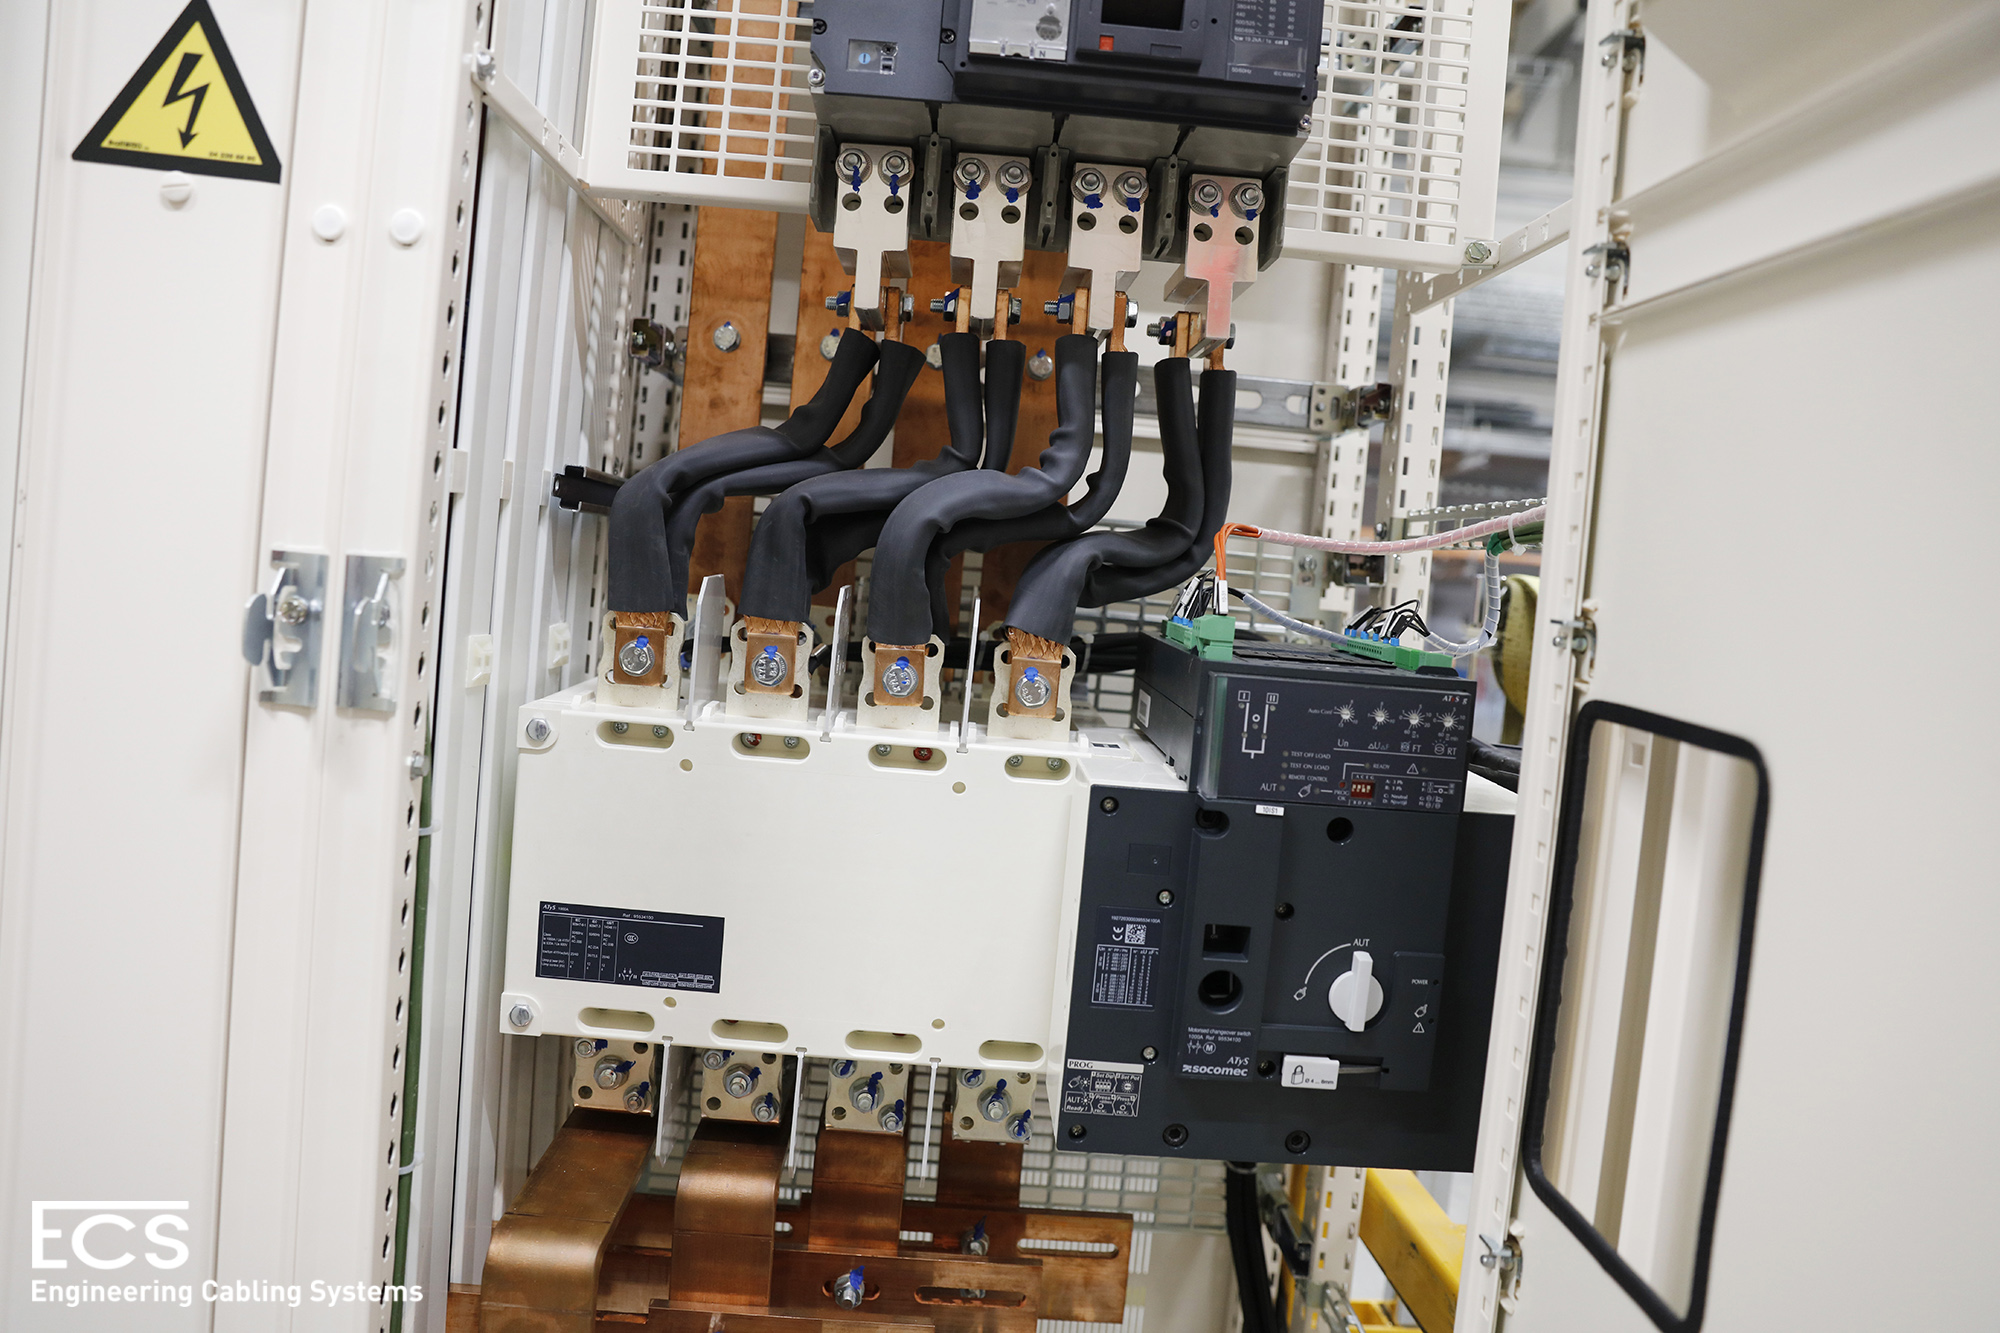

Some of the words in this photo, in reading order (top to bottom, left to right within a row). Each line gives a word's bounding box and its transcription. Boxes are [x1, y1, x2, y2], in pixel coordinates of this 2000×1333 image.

[1337, 739, 1349, 747] Un
[1260, 783, 1277, 791] AUT
[1353, 938, 1370, 947] AUT
[1227, 1056, 1250, 1067] ATyS
[1192, 1065, 1248, 1076] socomec
